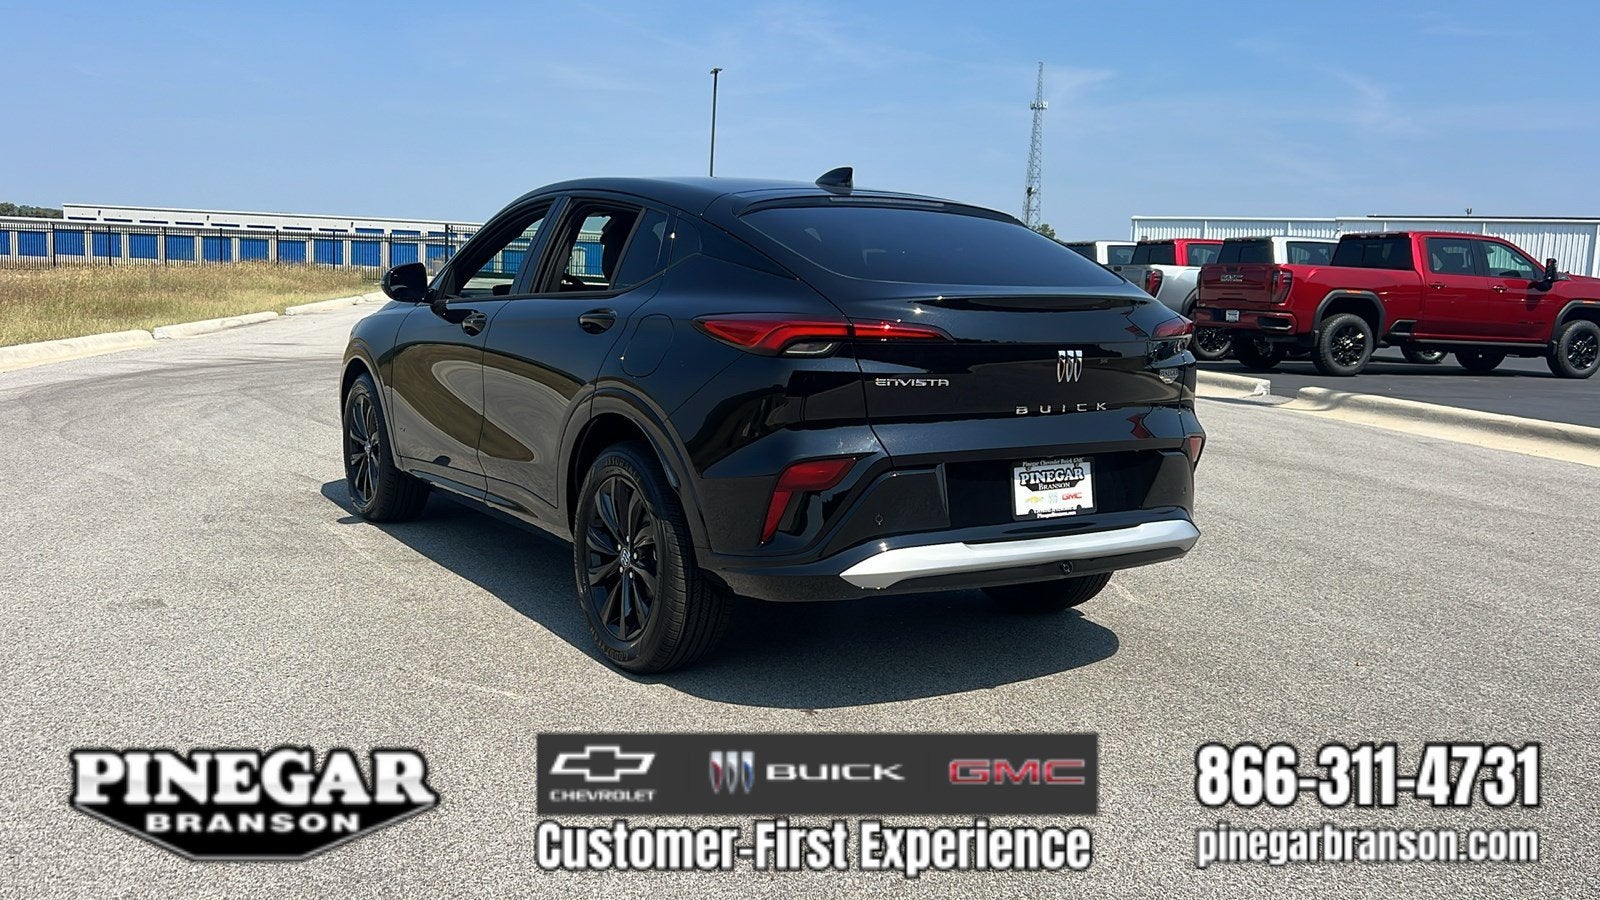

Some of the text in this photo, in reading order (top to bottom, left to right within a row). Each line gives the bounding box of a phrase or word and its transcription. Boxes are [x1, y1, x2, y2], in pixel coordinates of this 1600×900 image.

[875, 377, 949, 387] ENVISTA
[1015, 402, 1108, 415] BUICK
[1020, 468, 1085, 485] PINEGAR
[1038, 482, 1071, 491] BRANSON
[1062, 492, 1083, 500] GMC
